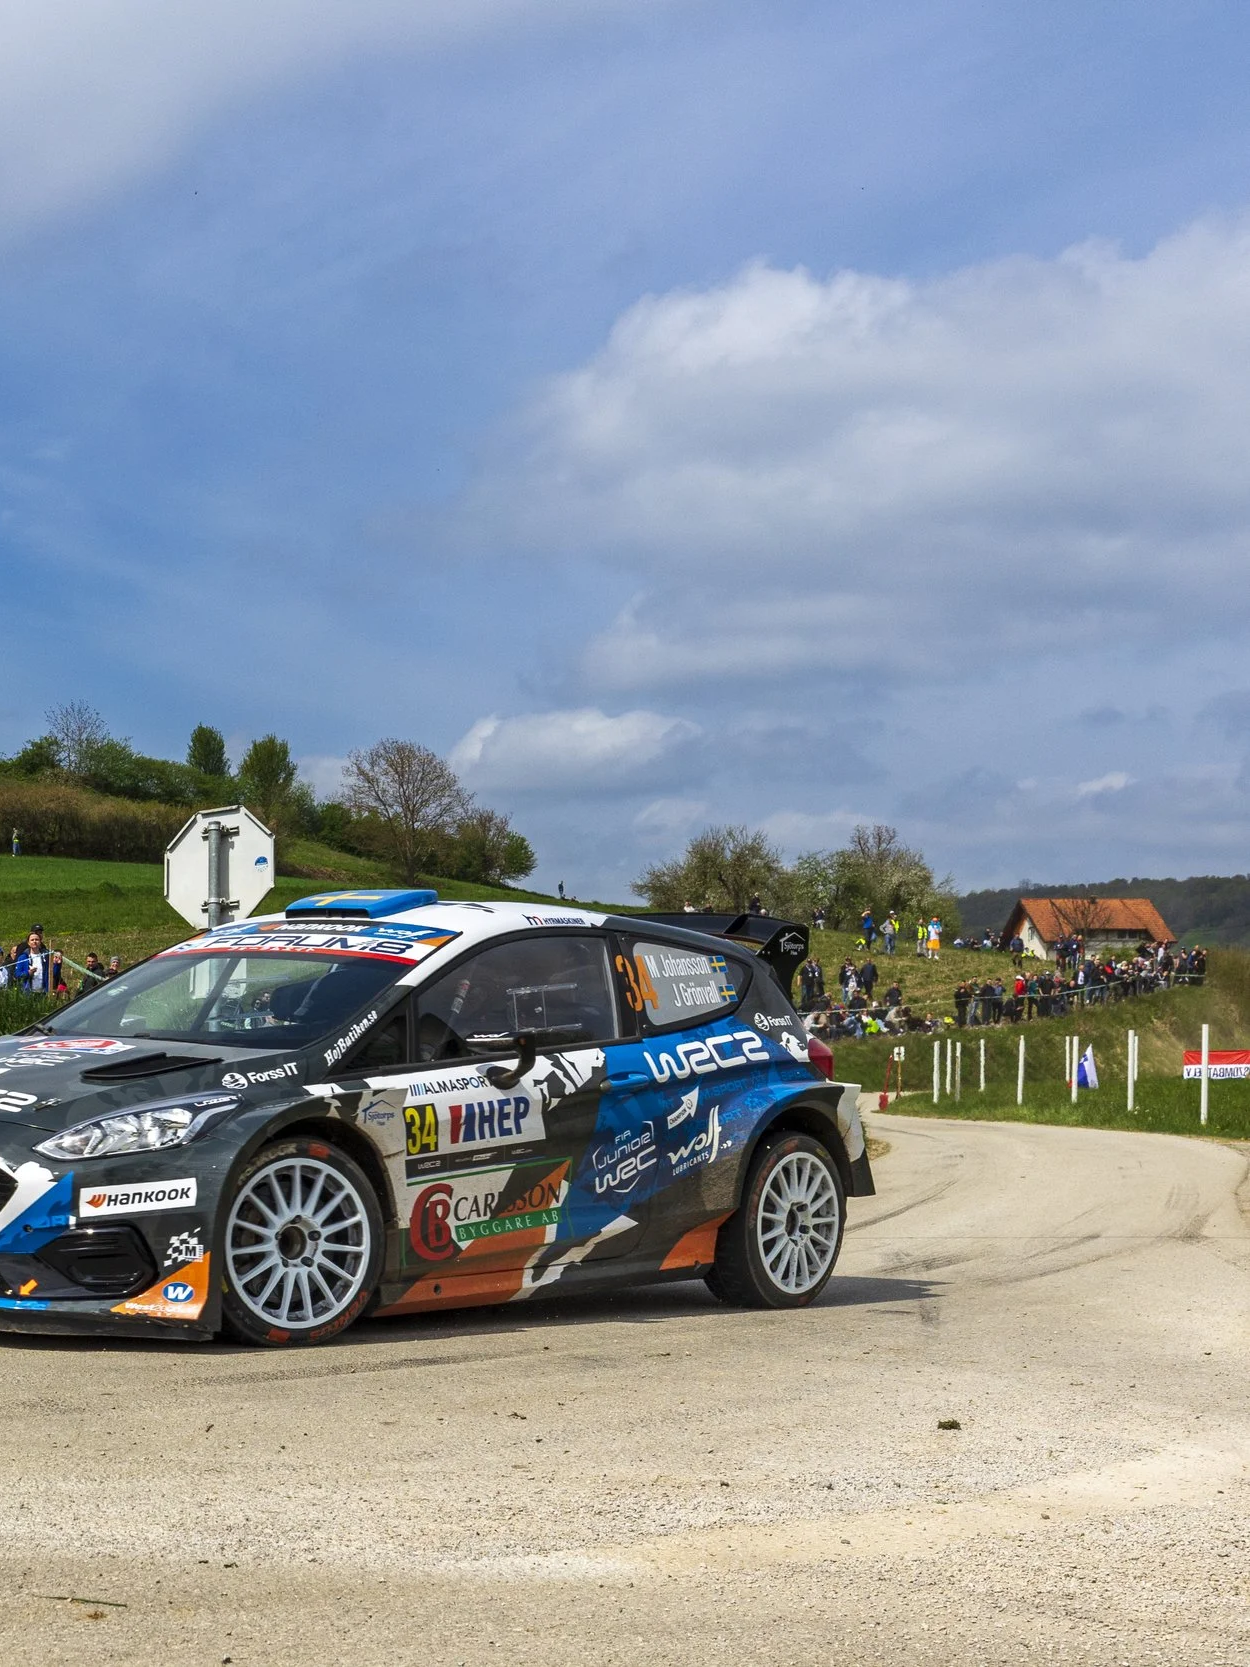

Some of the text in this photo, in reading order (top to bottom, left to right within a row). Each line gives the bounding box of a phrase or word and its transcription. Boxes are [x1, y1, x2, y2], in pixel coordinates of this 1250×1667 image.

[616, 954, 659, 1011] 34
[644, 955, 711, 979] M Johansson
[673, 981, 720, 1007] J Grönvall
[644, 1031, 770, 1084] WRC2
[424, 1076, 492, 1095] ALMASPOR
[405, 1105, 437, 1155] 34
[478, 1096, 530, 1139] HEP
[615, 1130, 631, 1144] FIA
[595, 1145, 657, 1193] WRC
[672, 1151, 710, 1176] LUBRICANTS
[454, 1182, 562, 1222] CARSON
[458, 1210, 559, 1240] BYGGARE AB
